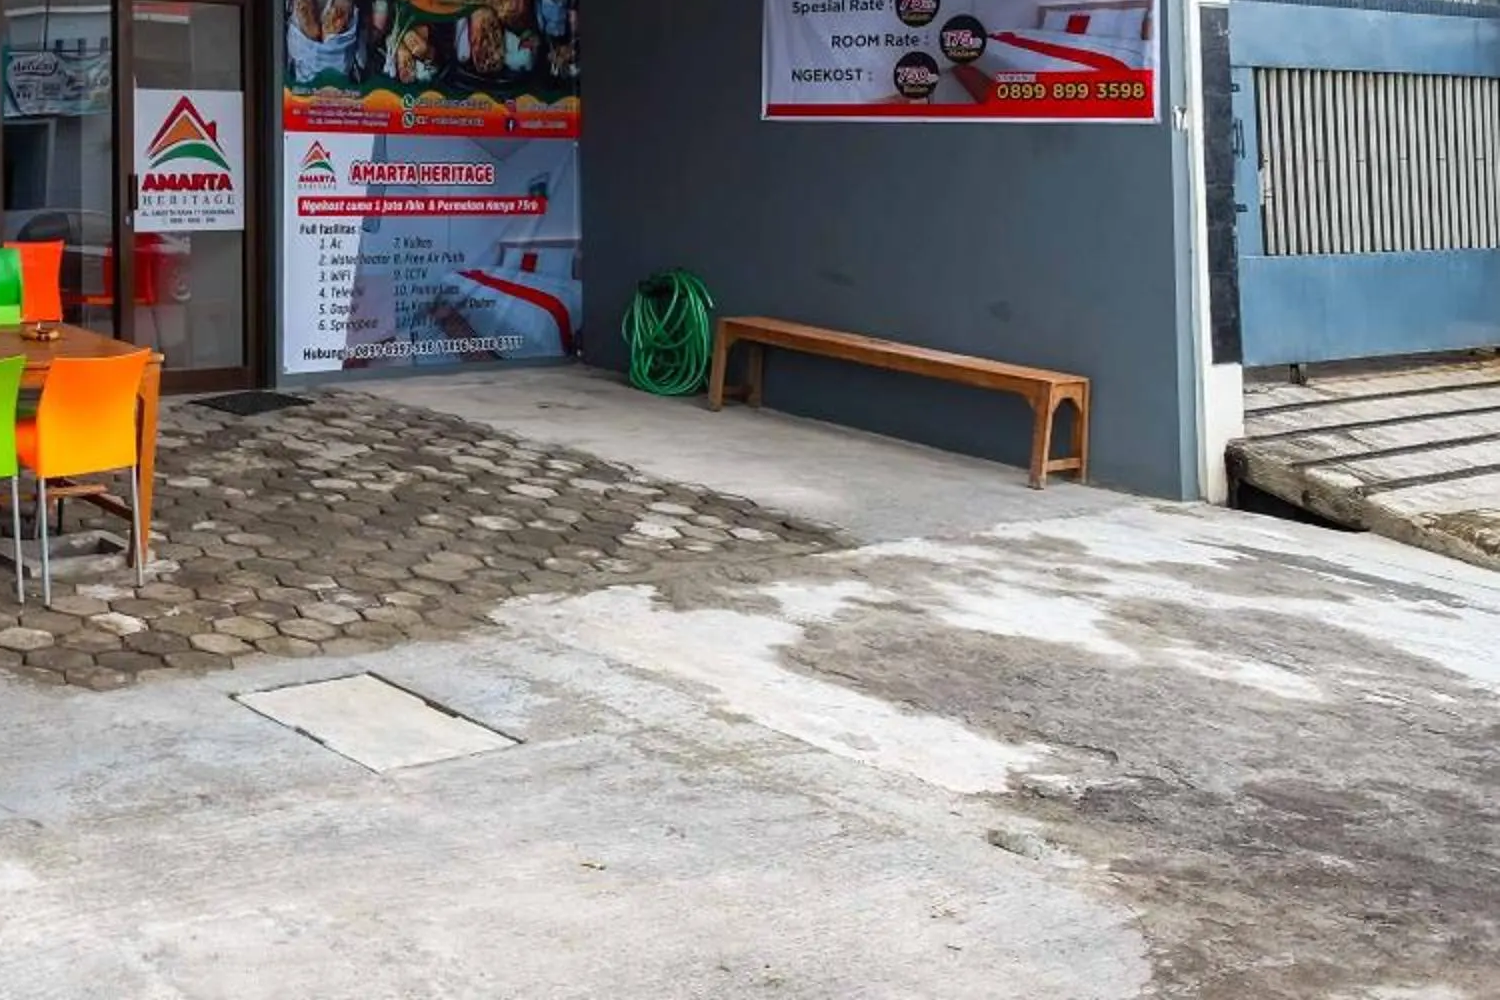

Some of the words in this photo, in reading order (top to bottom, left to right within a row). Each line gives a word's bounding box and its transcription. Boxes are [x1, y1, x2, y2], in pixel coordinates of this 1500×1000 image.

[792, 0, 845, 16] Spesial
[831, 34, 880, 48] ROOM
[885, 33, 920, 46] Rate
[791, 68, 863, 83] NGEKOST
[997, 83, 1047, 99] 0899
[1052, 83, 1089, 99] 899
[1096, 82, 1145, 99] 3598
[351, 165, 417, 183] AMARTA
[420, 164, 494, 183] HERITAGE
[141, 173, 233, 191] AMARTA
[142, 195, 235, 205] HERITAGE
